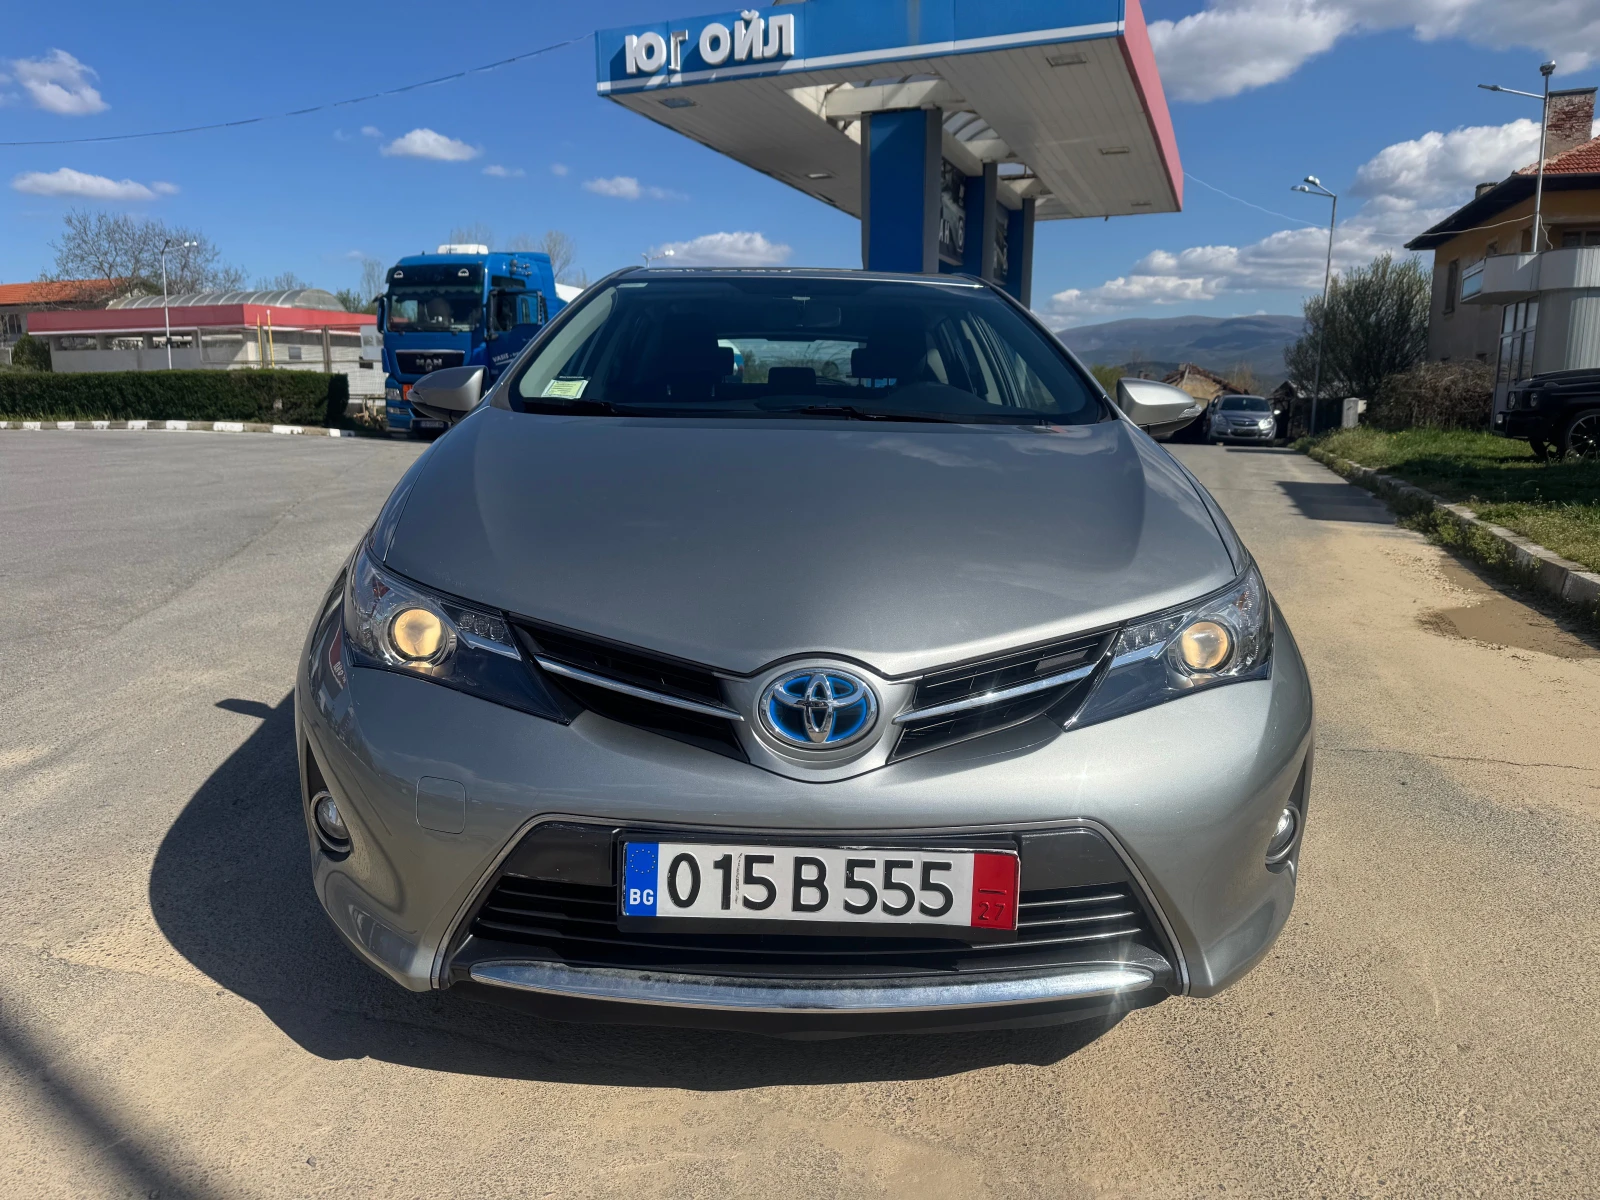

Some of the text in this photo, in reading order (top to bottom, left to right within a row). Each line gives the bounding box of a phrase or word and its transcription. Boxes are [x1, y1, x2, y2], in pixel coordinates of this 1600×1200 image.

[625, 9, 795, 75] ЮГ ОЙЛ
[416, 358, 443, 367] MAN
[629, 888, 654, 905] BG
[978, 901, 1006, 921] 27
